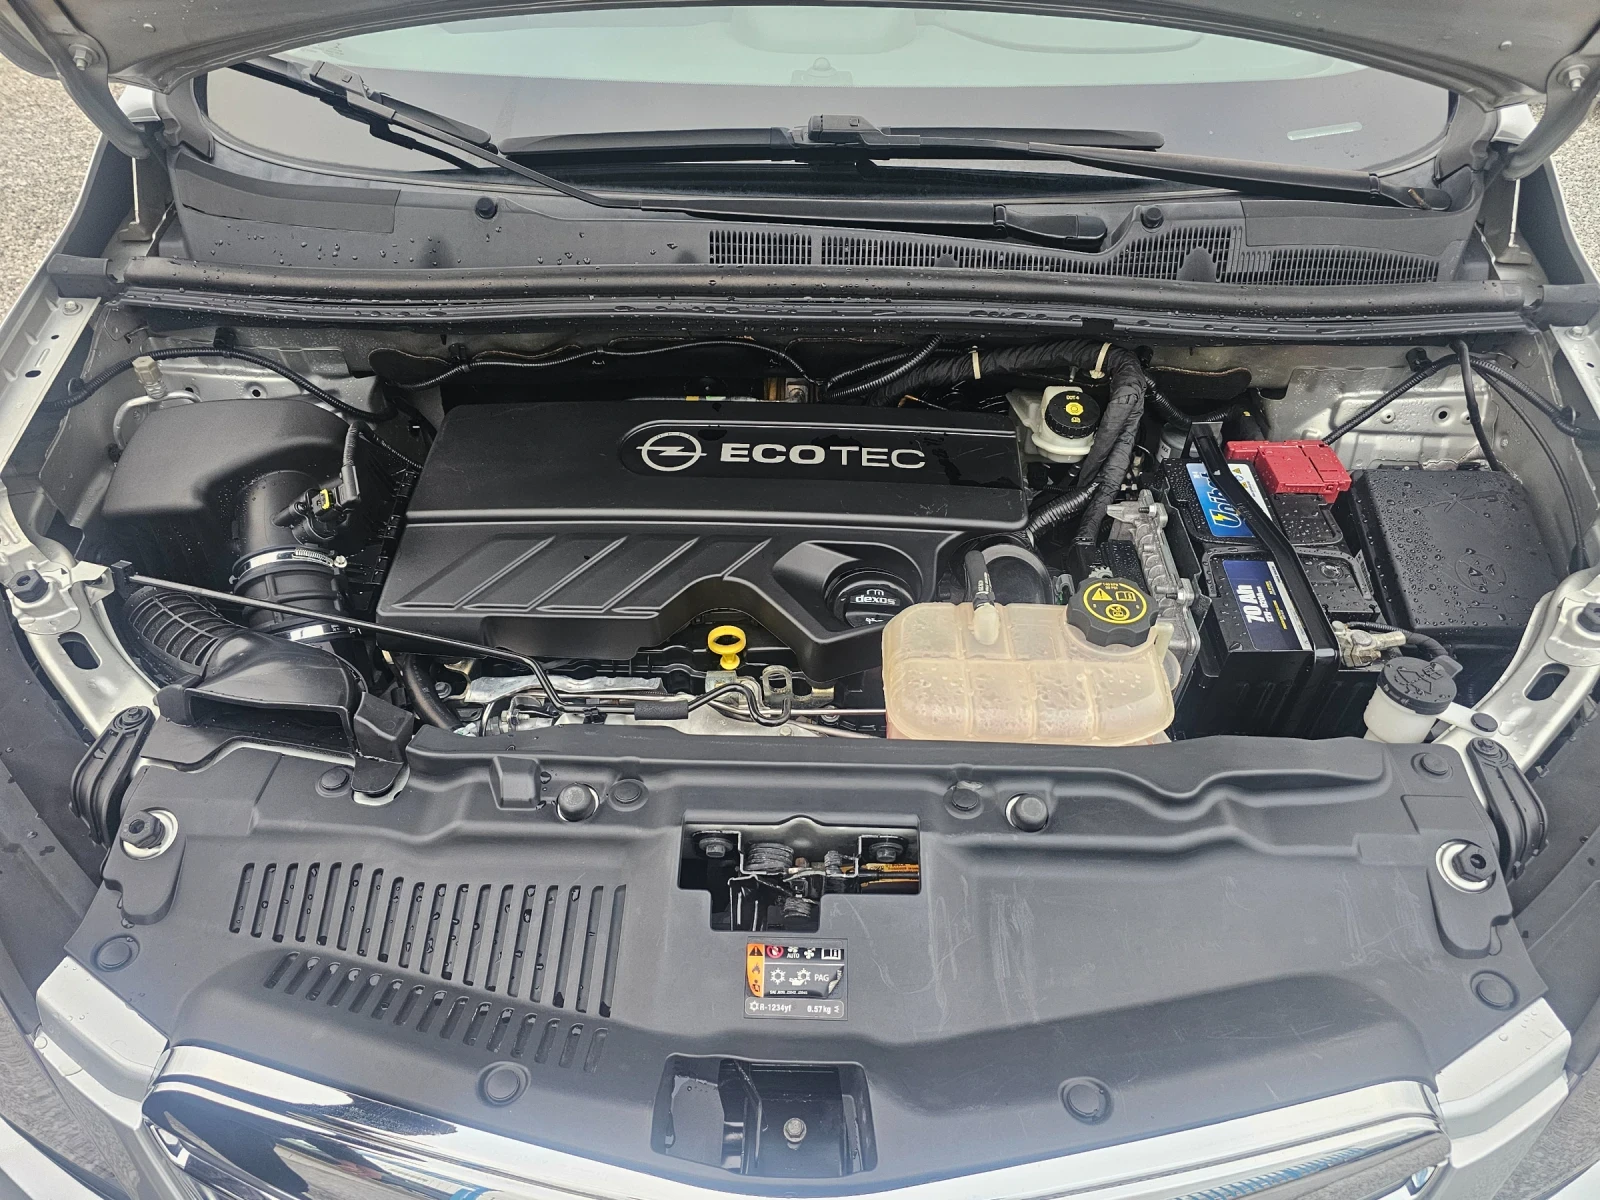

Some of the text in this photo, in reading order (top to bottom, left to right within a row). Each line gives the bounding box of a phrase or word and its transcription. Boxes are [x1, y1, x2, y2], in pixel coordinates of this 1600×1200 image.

[719, 442, 926, 469] ECOTEC
[855, 594, 896, 605] dexos
[1236, 585, 1266, 623] 70 Ah
[1263, 611, 1274, 623] 12V
[814, 974, 830, 982] PAG
[759, 1003, 792, 1013] R-1234yf
